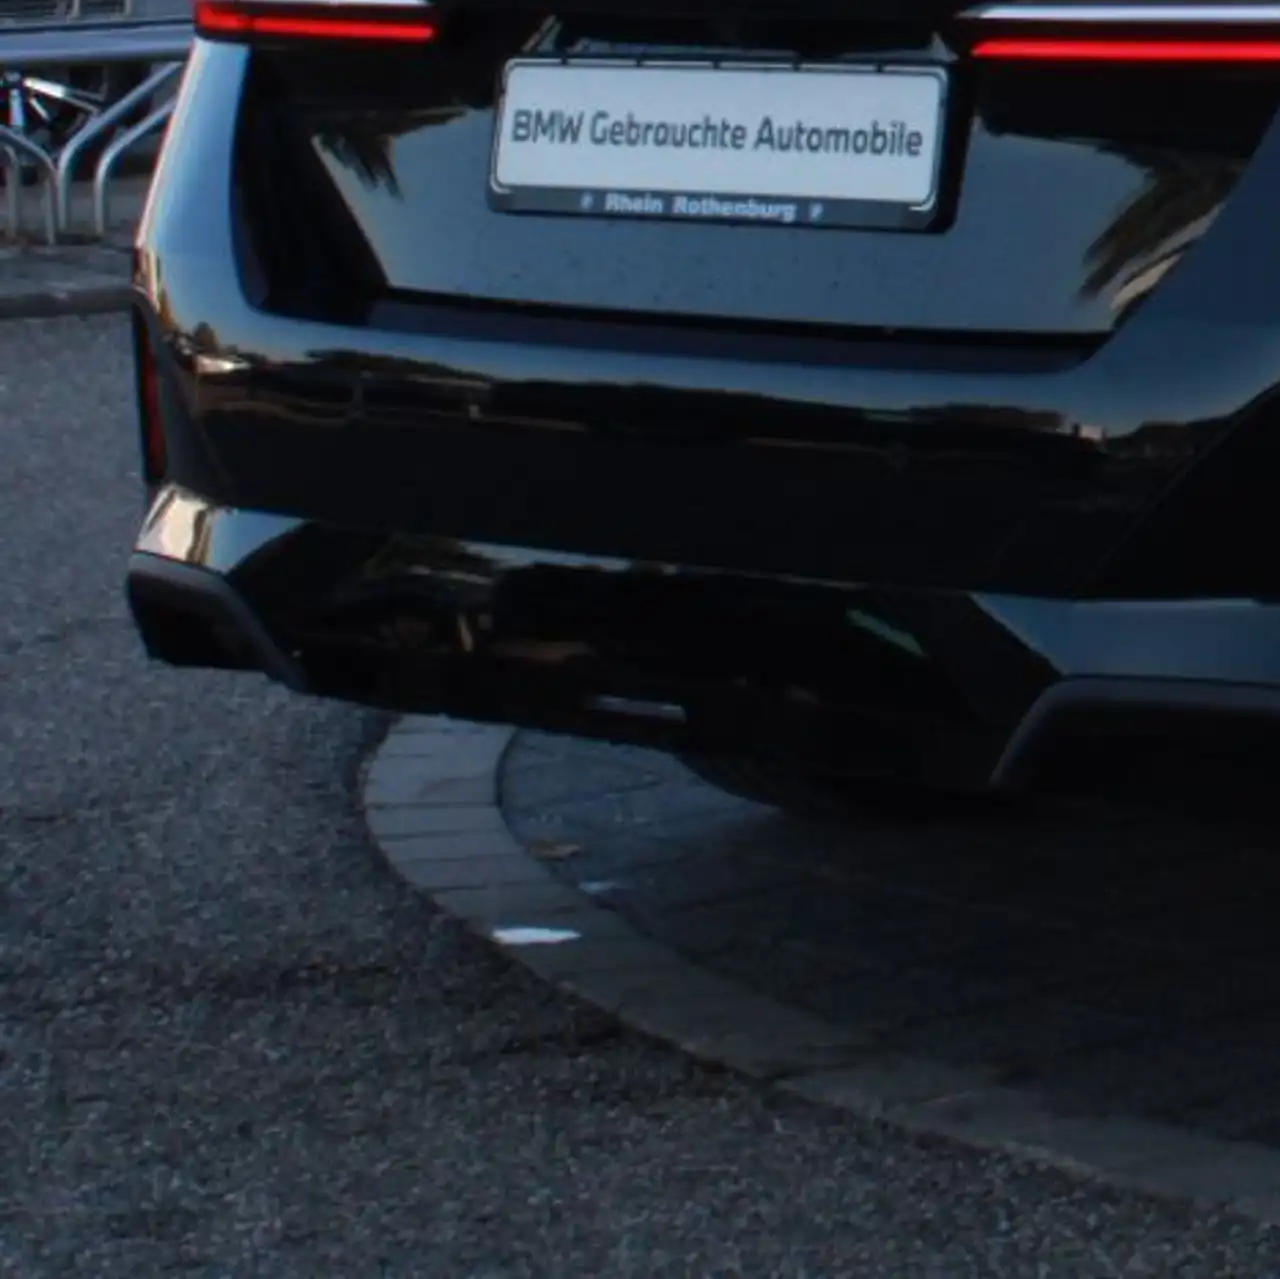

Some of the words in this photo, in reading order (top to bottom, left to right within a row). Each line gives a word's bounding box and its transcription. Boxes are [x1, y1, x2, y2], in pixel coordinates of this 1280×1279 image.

[512, 108, 585, 144] BMW
[589, 110, 747, 151] Gebrauchte
[753, 116, 923, 158] Automobile
[604, 192, 664, 214] Rhein
[672, 195, 797, 223] Rothenburg
